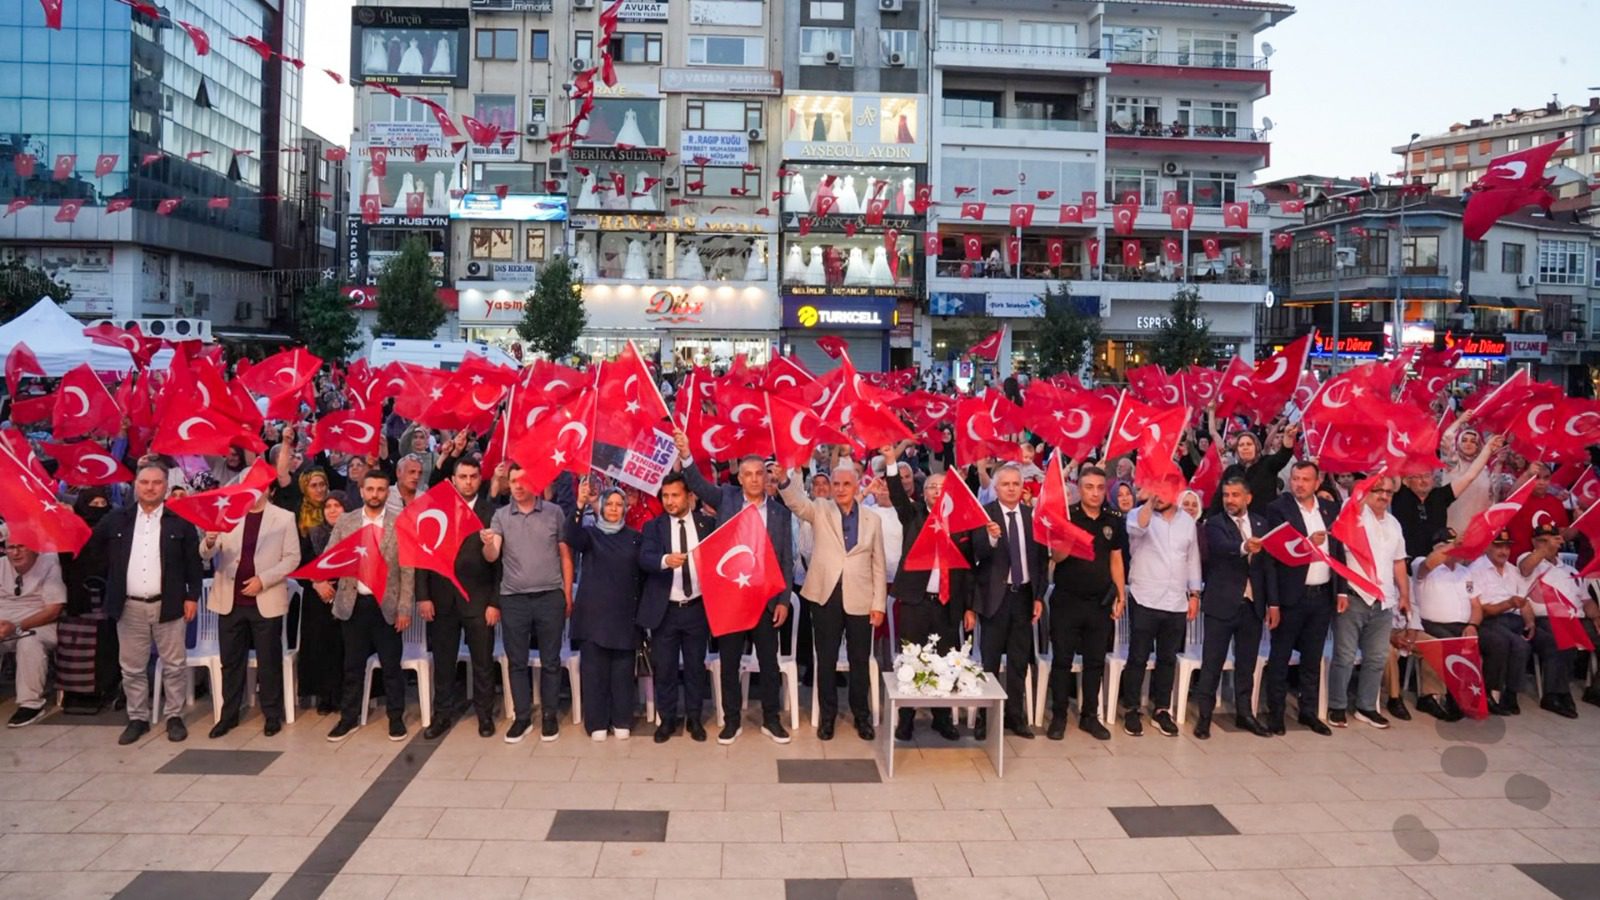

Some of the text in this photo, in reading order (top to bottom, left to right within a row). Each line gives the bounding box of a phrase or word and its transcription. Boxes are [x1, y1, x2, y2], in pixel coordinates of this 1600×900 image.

[572, 148, 617, 160] BERİKA
[801, 142, 911, 159] AYŞEGÜL AYDIN
[818, 309, 882, 324] TURKCELL
[1324, 336, 1373, 352] Lier Döner
[1478, 338, 1505, 354] Döner
[1513, 341, 1542, 351] ECZANE
